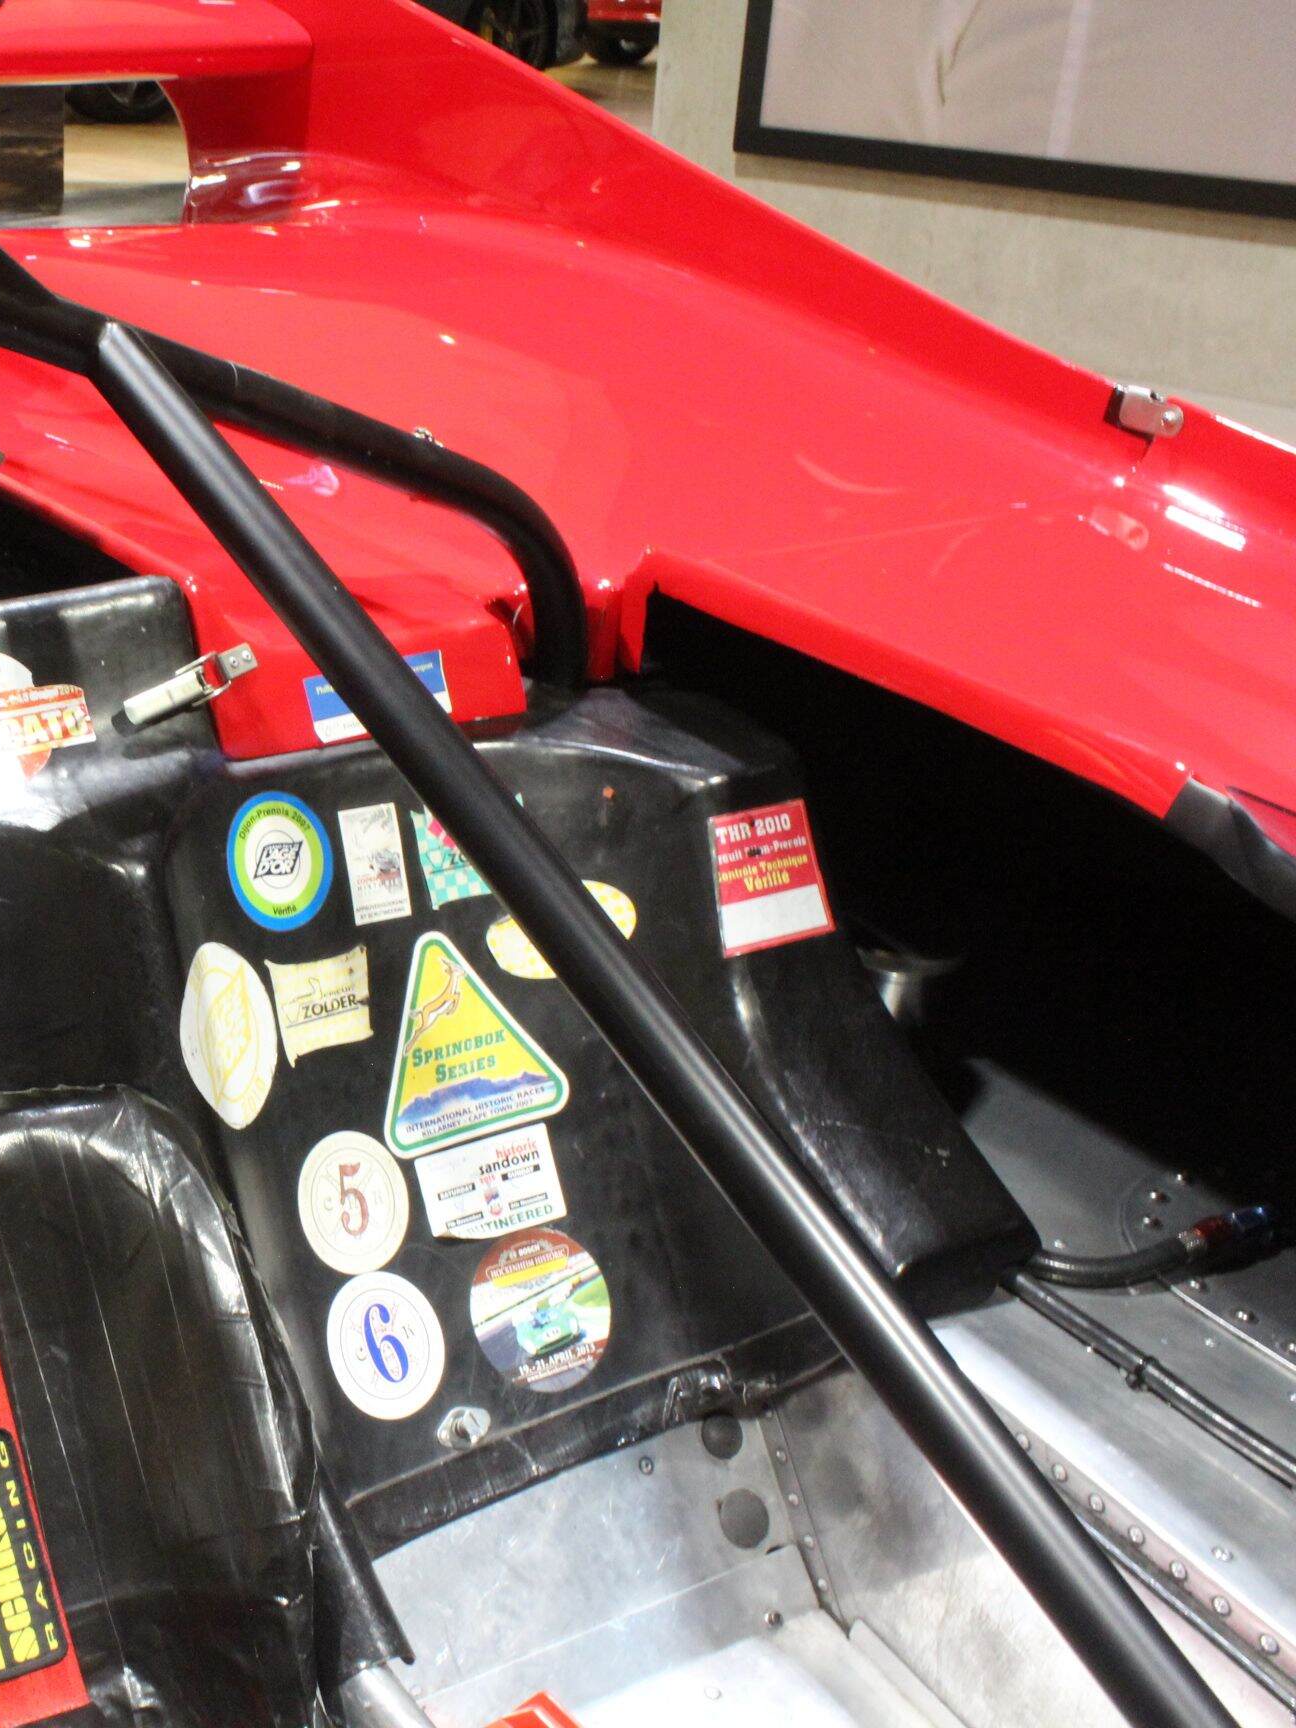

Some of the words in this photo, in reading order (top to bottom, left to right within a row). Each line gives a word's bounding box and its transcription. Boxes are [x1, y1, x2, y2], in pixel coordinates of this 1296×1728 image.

[755, 813, 792, 837] 2010
[302, 993, 358, 1019] ZOLDER
[406, 1107, 472, 1133] INTERNATIONAL
[475, 1094, 513, 1112] HISTORIC
[517, 1085, 546, 1100] RACES
[468, 1111, 488, 1123] CAPE
[490, 1103, 513, 1115] TOWN
[495, 1138, 538, 1160] historic
[479, 1150, 540, 1175] sandown
[338, 1162, 369, 1236] 5
[442, 1184, 473, 1200] SATURDAY
[364, 1303, 409, 1383] 6
